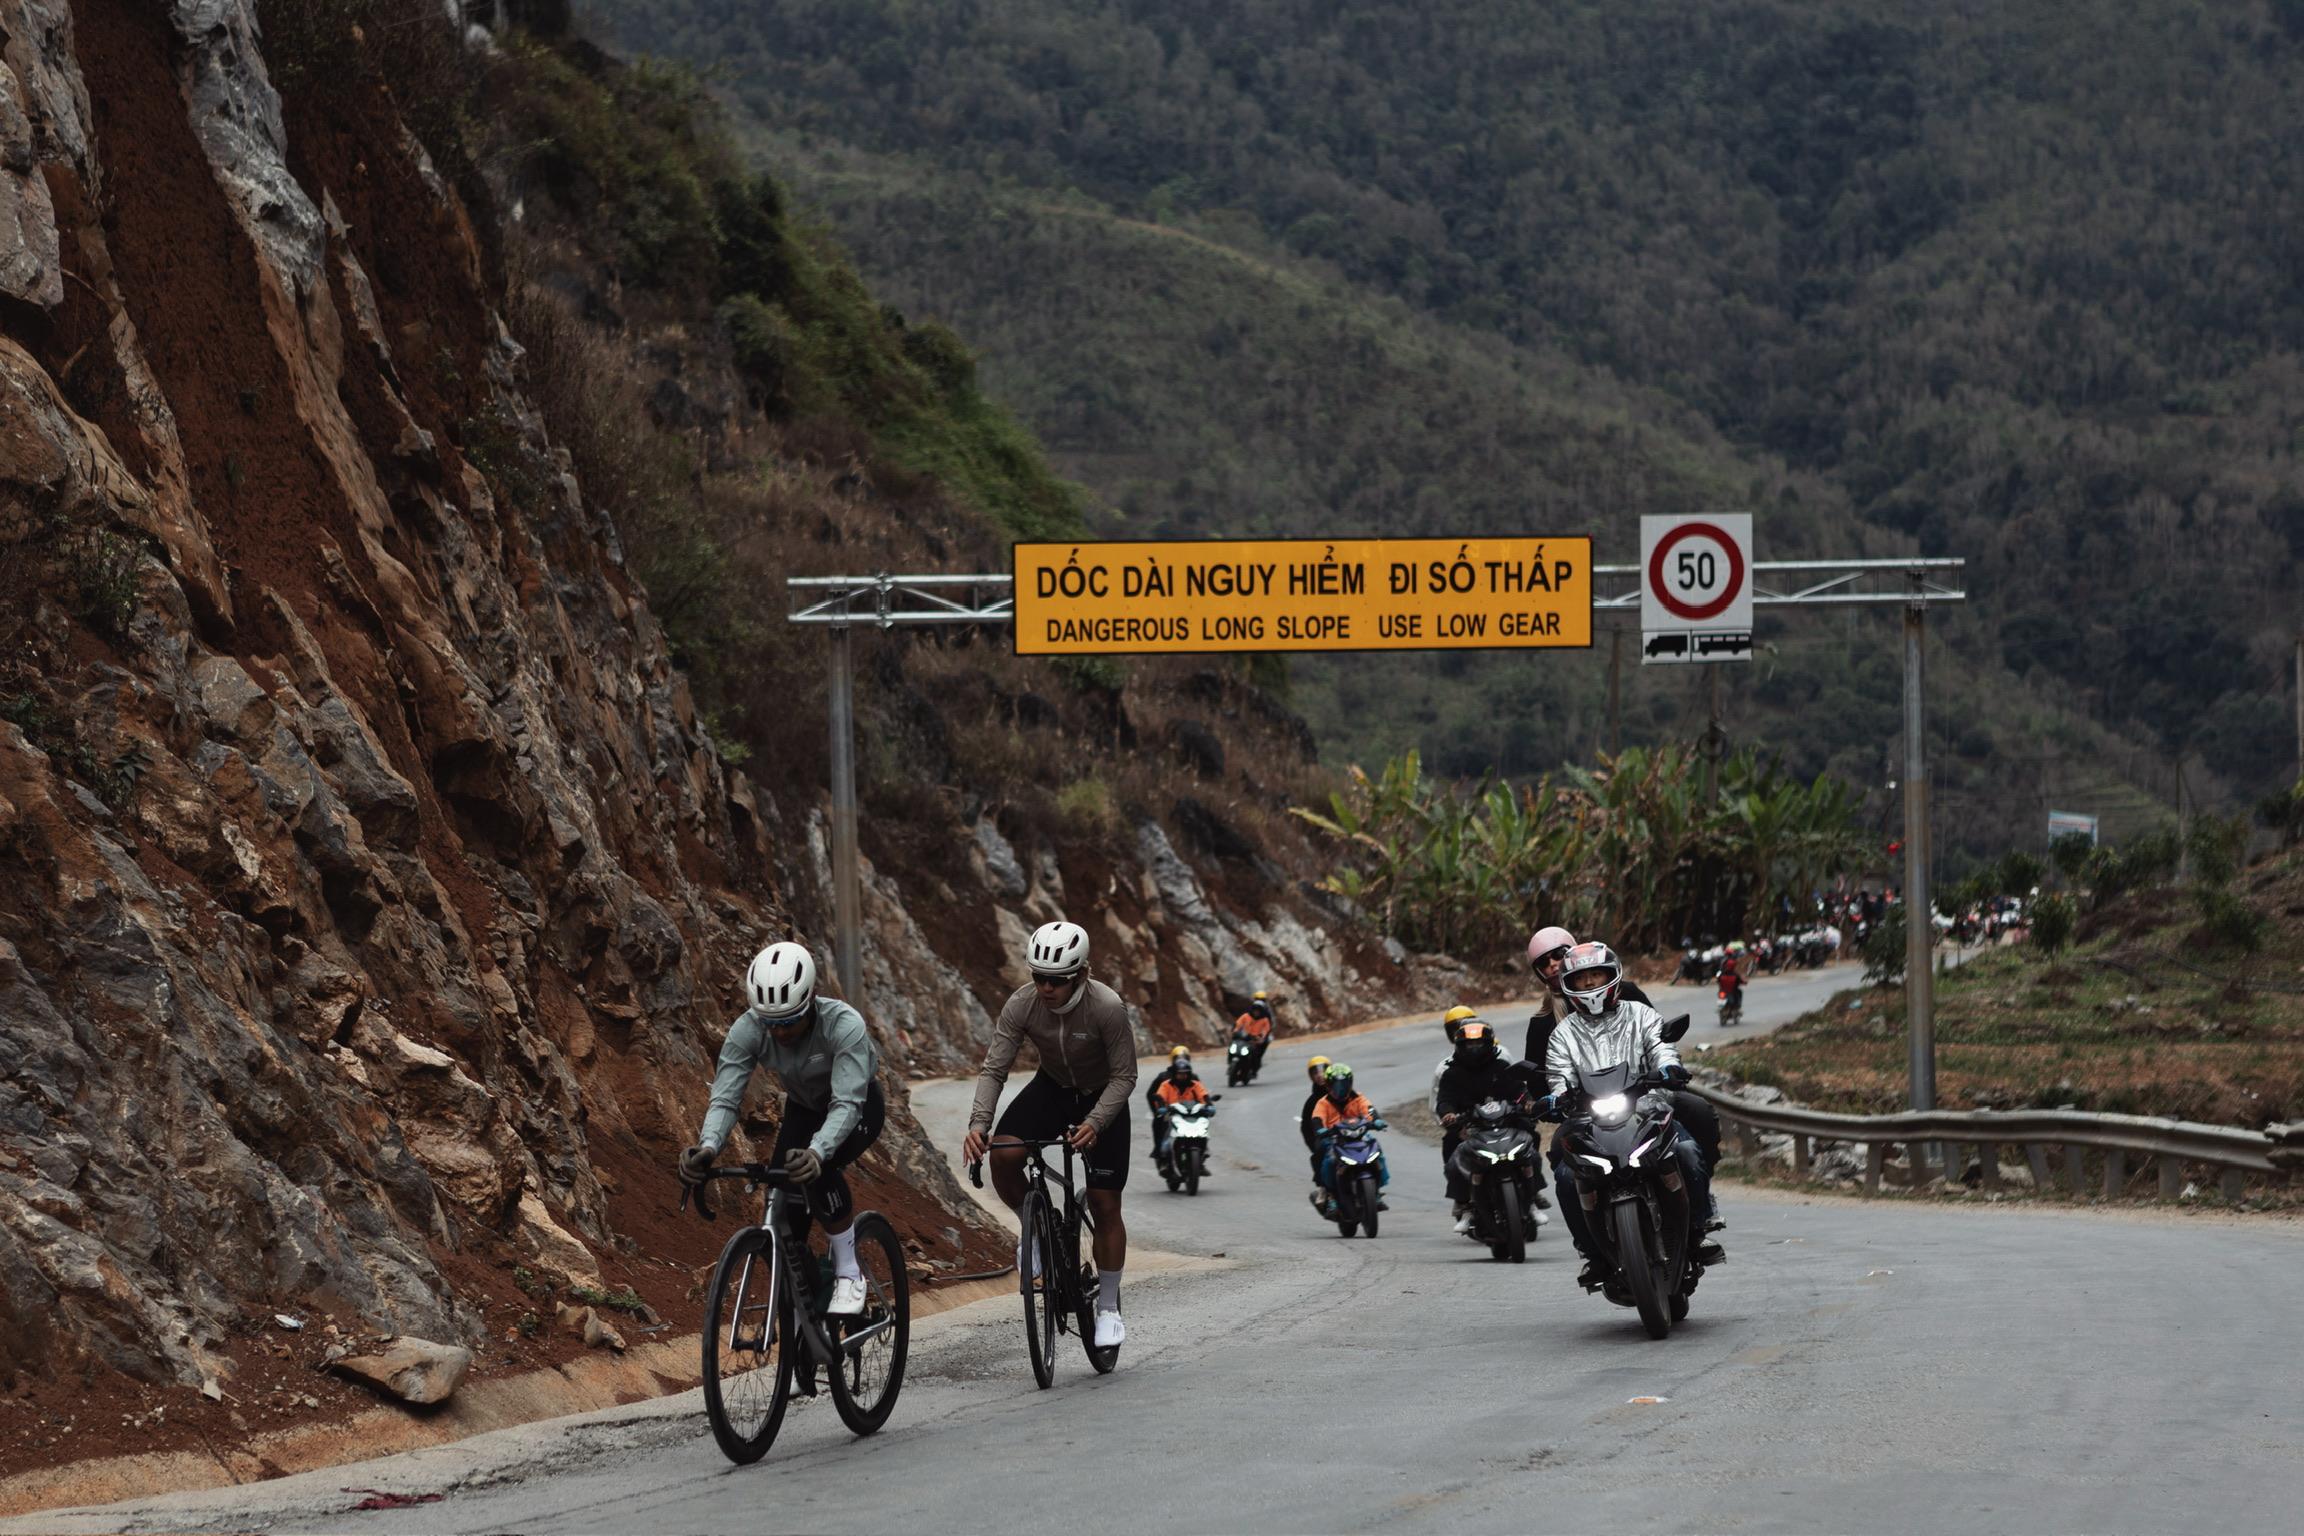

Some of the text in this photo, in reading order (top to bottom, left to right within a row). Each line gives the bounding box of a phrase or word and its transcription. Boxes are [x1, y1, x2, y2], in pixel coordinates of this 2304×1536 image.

[1037, 544, 1573, 598] DỐC DÀI NGUY HIỂM ĐI SỐ THẤP
[1678, 552, 1715, 590] 50
[1047, 613, 1561, 642] DANGEROUS LONG SLOPE USE LOW GEAR
